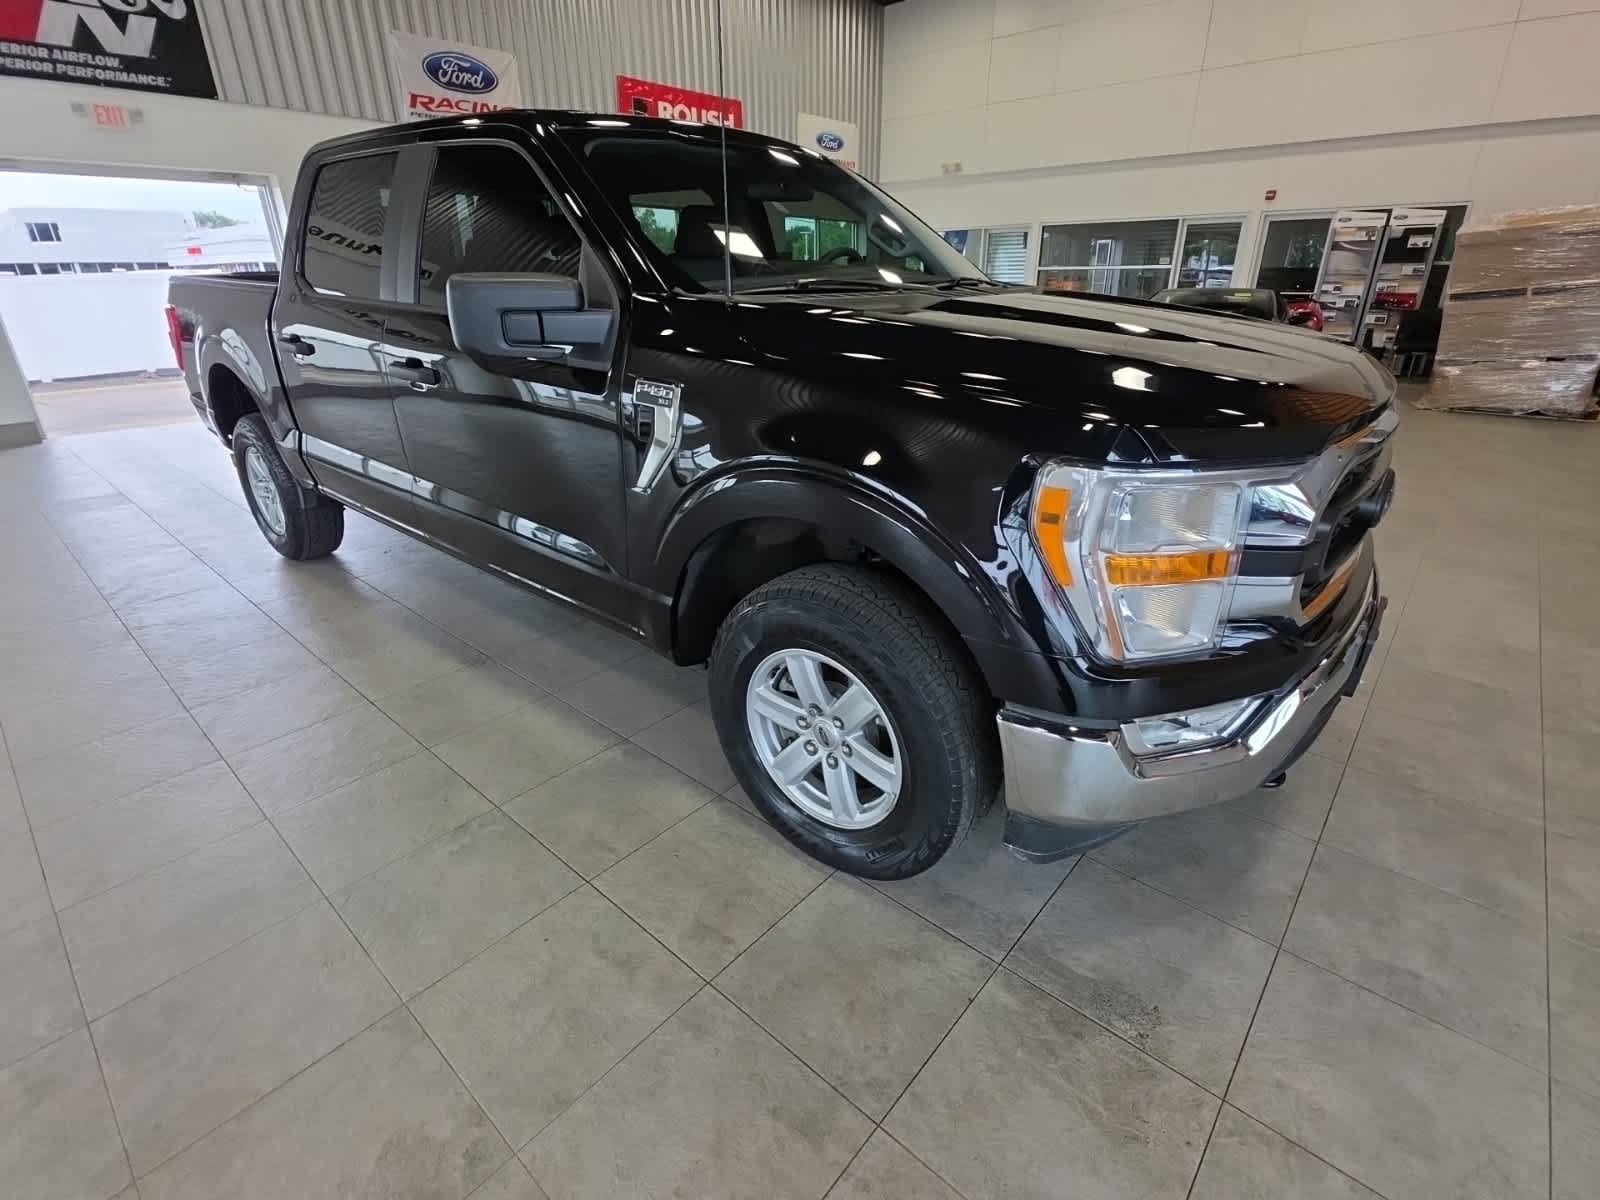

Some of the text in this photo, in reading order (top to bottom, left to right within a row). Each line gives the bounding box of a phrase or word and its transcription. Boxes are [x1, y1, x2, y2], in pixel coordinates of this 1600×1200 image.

[52, 48, 124, 69] AIRFLOW.
[438, 56, 486, 89] Ford
[409, 93, 515, 114] RACIN
[657, 100, 736, 128] ROUSH
[95, 104, 126, 127] EXIT
